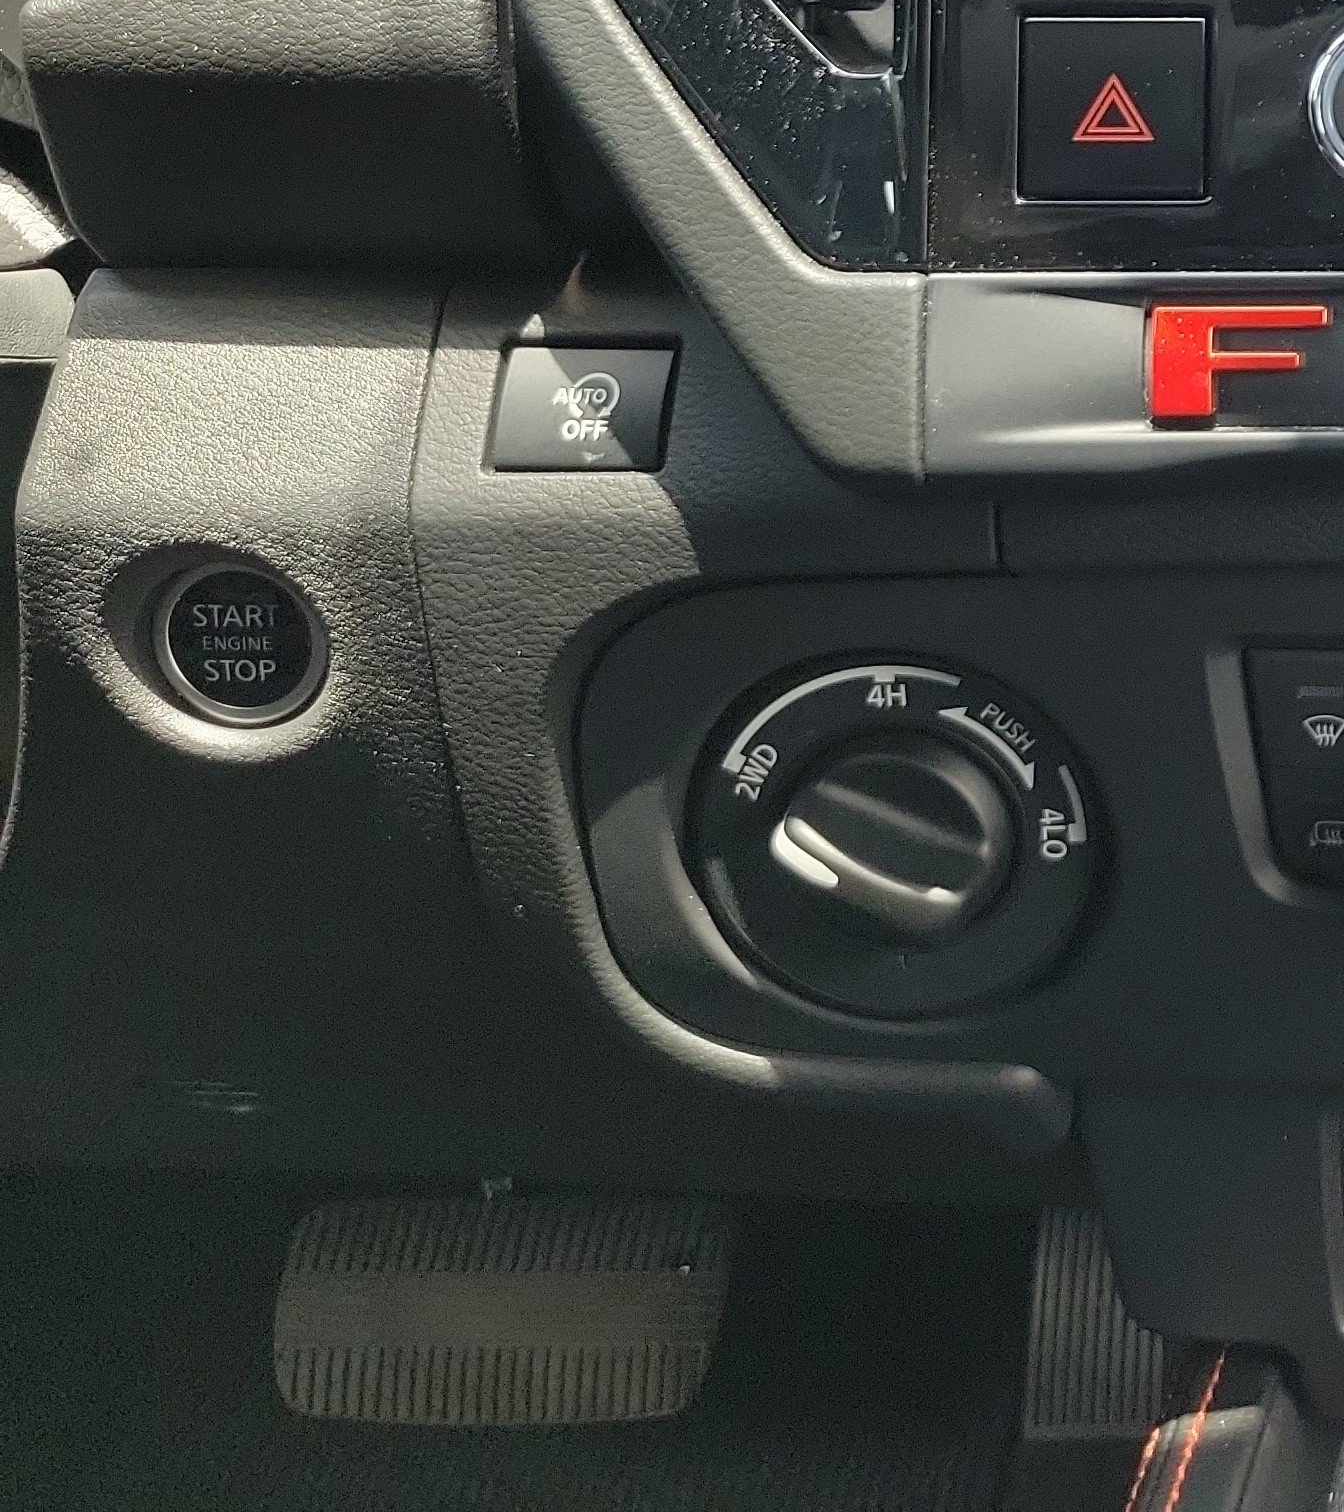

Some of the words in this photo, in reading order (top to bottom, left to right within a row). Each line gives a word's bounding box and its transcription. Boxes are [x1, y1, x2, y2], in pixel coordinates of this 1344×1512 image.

[553, 387, 607, 406] AUTO
[561, 419, 609, 441] OFF
[192, 604, 279, 629] START
[202, 635, 272, 653] ENGINE
[203, 659, 278, 683] STOP
[867, 683, 908, 707] 4H
[979, 702, 1038, 754] PUSH
[734, 743, 779, 802] 2WD
[1039, 808, 1069, 862] 4LO
